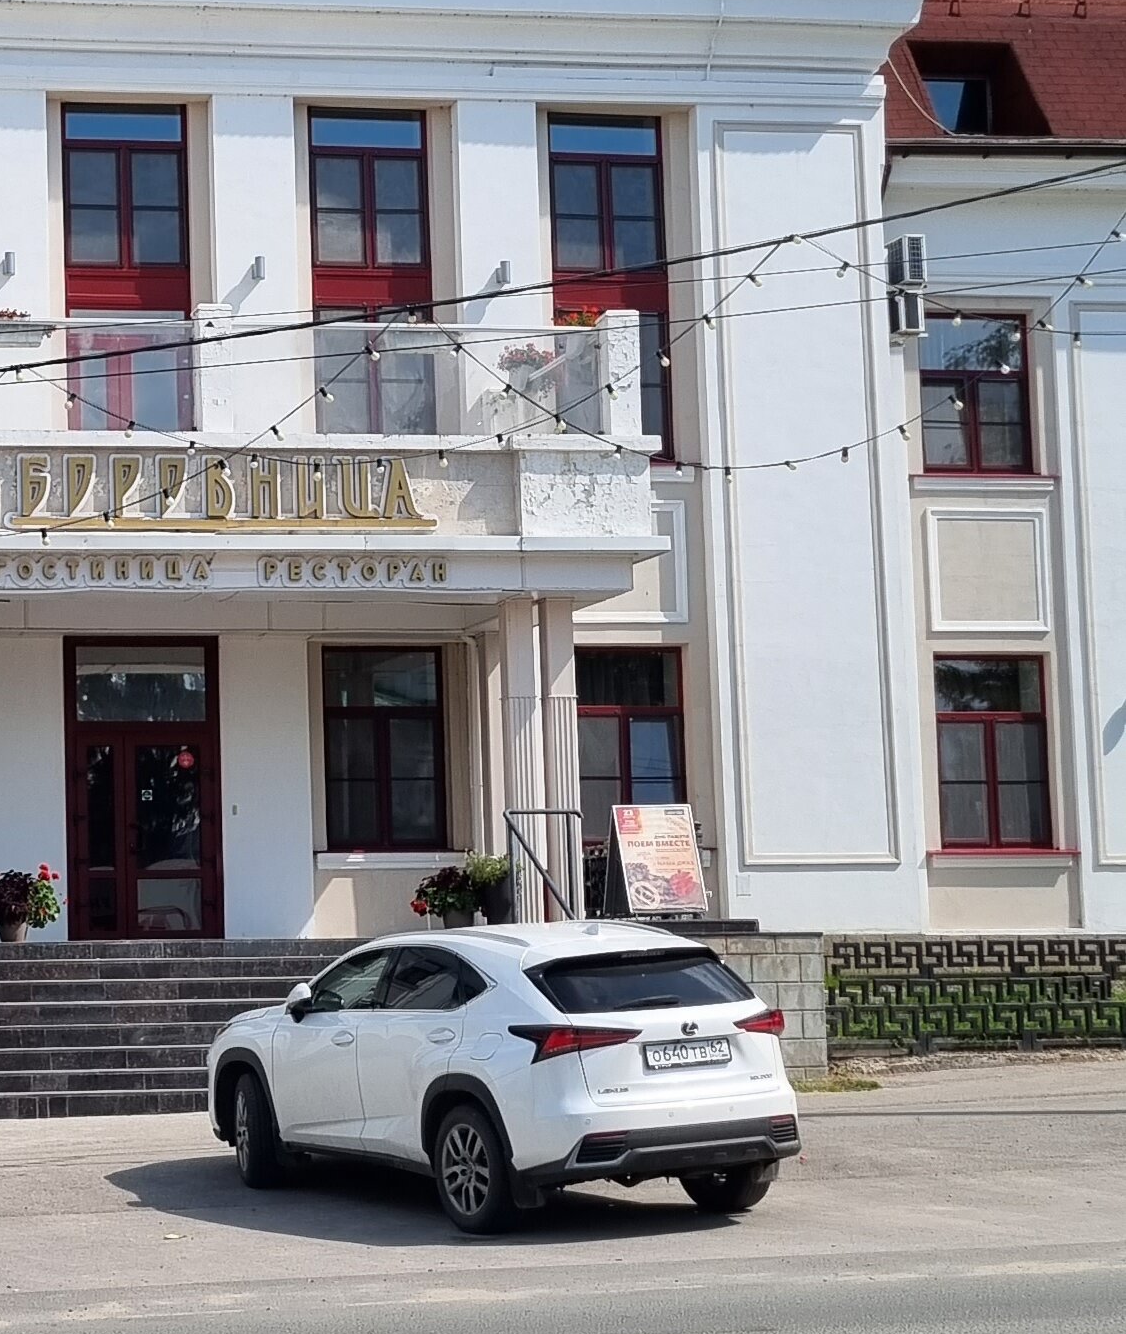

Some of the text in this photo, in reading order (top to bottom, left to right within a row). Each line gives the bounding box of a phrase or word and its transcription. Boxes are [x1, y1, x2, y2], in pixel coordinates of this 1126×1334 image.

[17, 453, 425, 519] БОРОВНИЦА
[263, 556, 449, 583] РЕСТОРАН
[627, 839, 691, 848] ПОЕМ ВМЕСТЕ
[710, 1040, 725, 1054] 62
